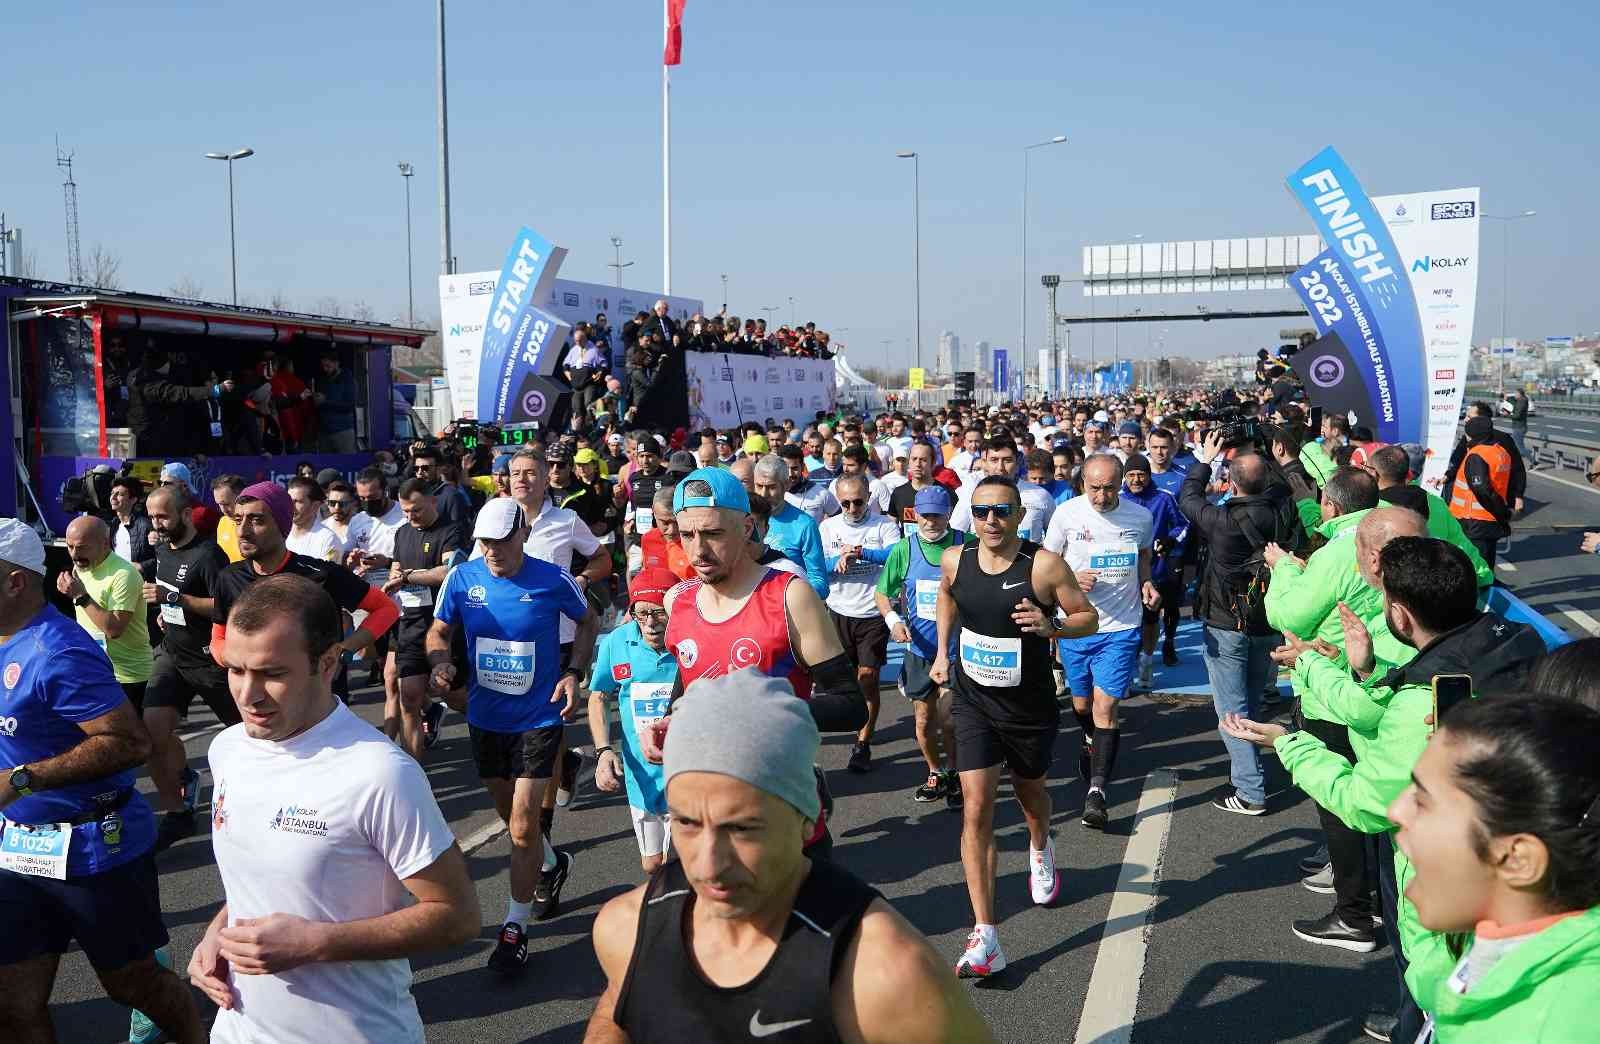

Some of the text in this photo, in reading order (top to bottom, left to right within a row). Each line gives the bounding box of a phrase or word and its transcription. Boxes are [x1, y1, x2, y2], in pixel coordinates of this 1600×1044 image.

[1302, 168, 1393, 283] FINISH
[493, 239, 540, 335] START
[1301, 271, 1343, 326] 2022
[523, 320, 549, 366] 2022
[1365, 339, 1381, 366] HALF
[1373, 363, 1394, 423] MARATHON
[1096, 557, 1130, 566] B 1205
[486, 657, 524, 671] B 1074
[972, 651, 1004, 666] A 417
[646, 703, 655, 713] E
[10, 832, 54, 852] B 1025
